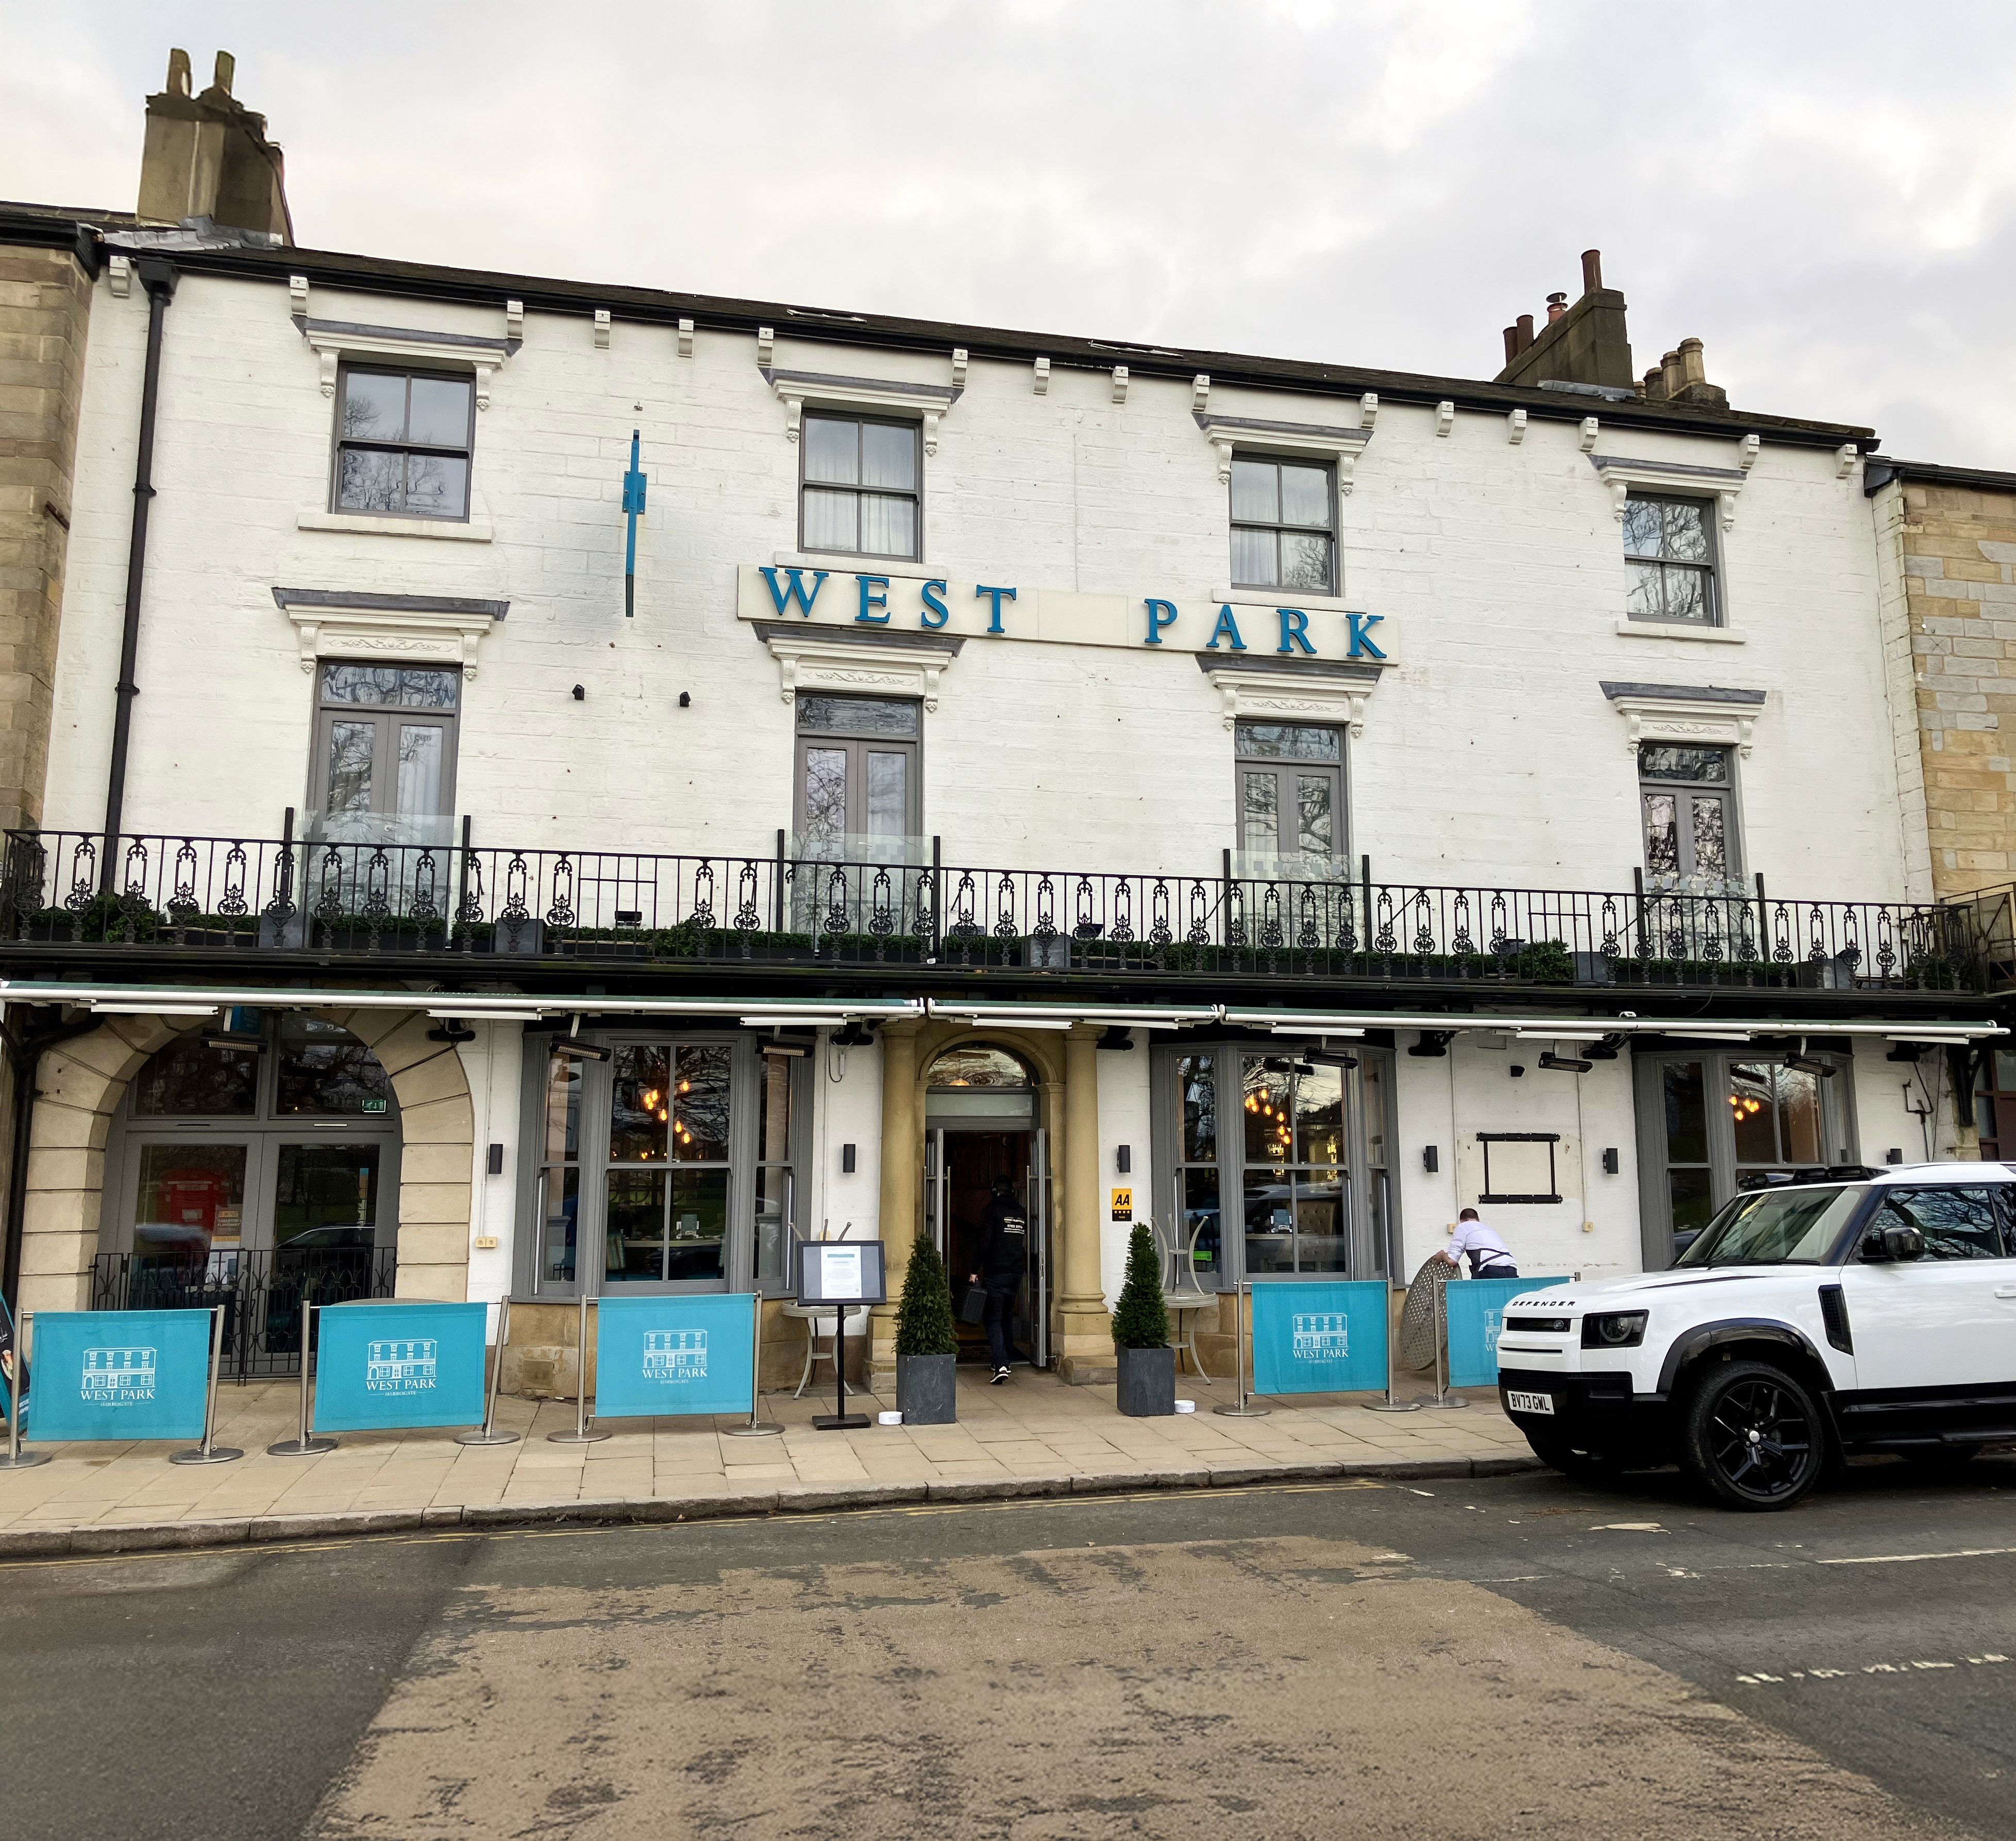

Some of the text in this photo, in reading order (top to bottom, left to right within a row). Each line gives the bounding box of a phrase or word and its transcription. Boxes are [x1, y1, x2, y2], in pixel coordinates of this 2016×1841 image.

[759, 566, 1387, 658] WEST PARK
[1115, 1194, 1130, 1206] AA
[1293, 1348, 1349, 1359] WEST PARK
[642, 1367, 708, 1379] WEST PARK
[366, 1378, 436, 1391] WEST PARK
[80, 1388, 156, 1400] WEST PARK
[1511, 1394, 1550, 1411] BV73 GWL
